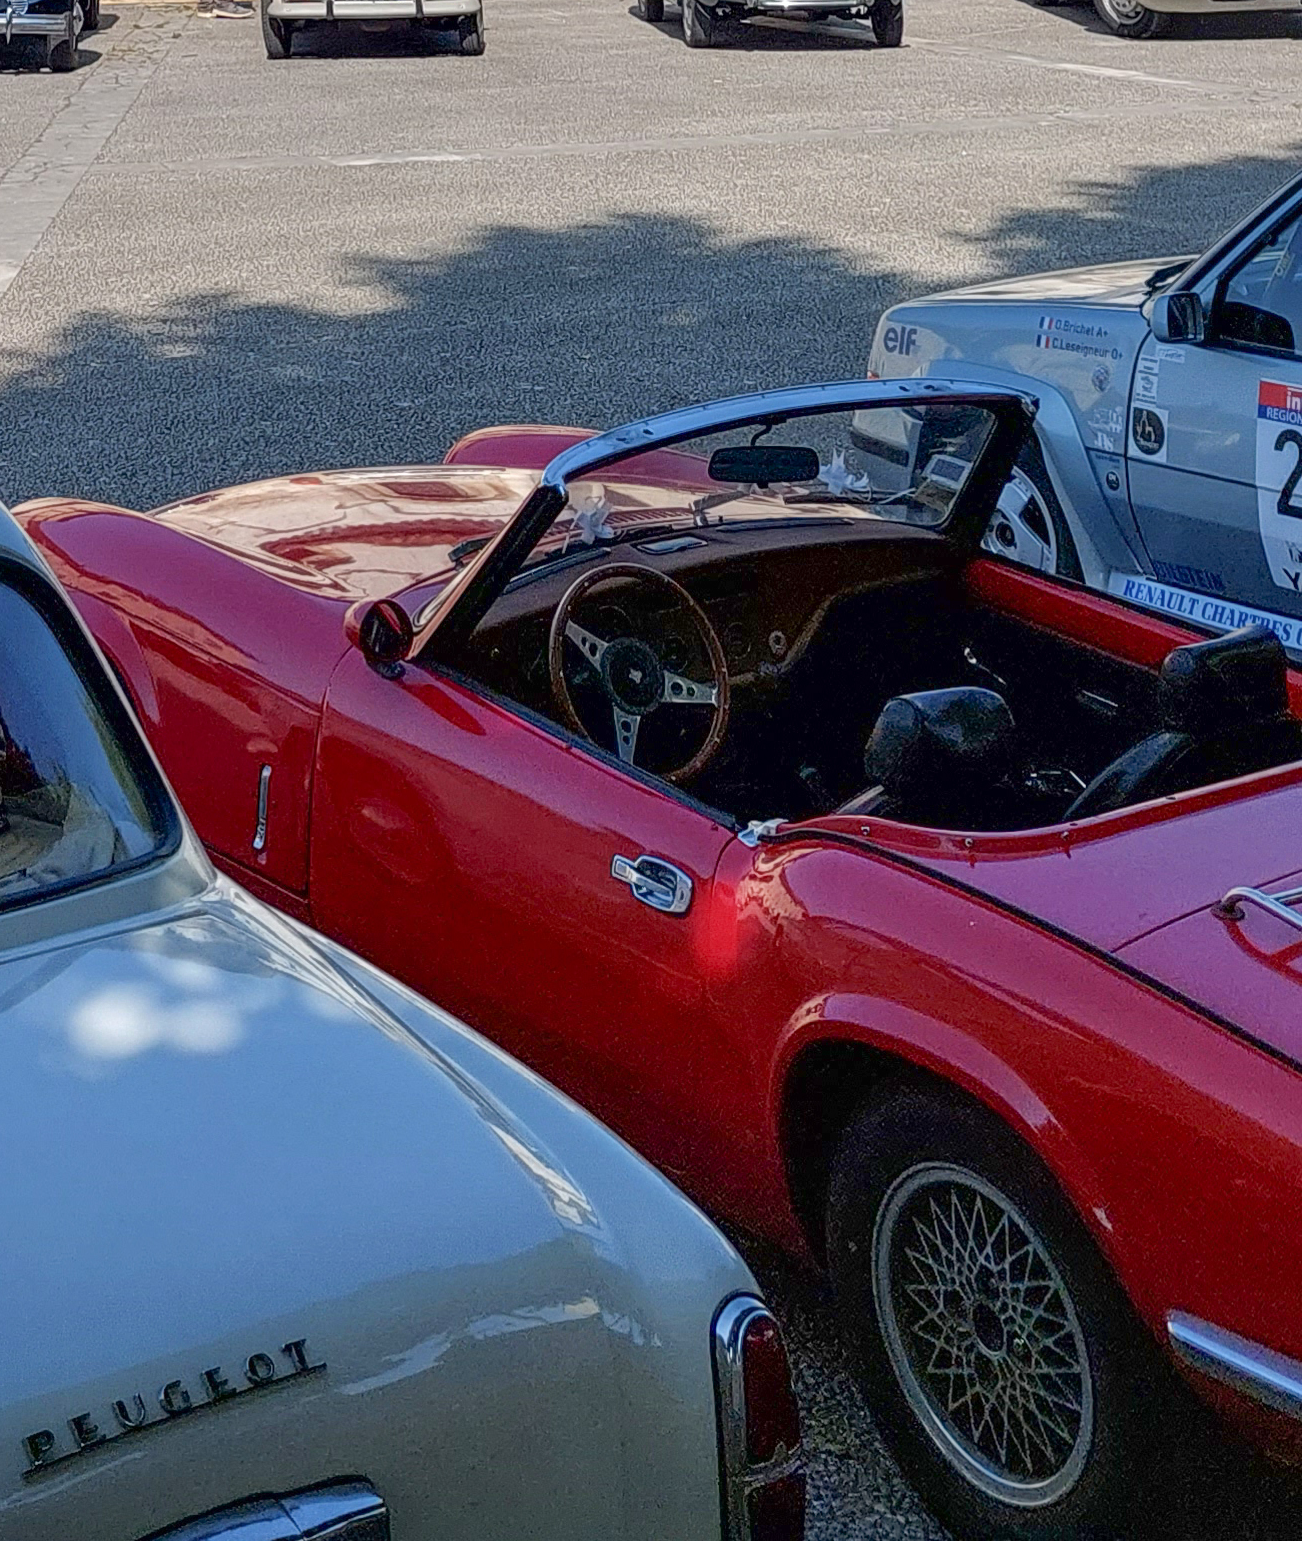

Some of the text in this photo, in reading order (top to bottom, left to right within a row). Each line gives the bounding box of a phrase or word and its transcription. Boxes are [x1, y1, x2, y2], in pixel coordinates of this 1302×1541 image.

[883, 325, 918, 356] elf
[1096, 326, 1109, 338] A+
[1123, 579, 1200, 616] RENAULT
[21, 1337, 328, 1473] PEUGEOT
